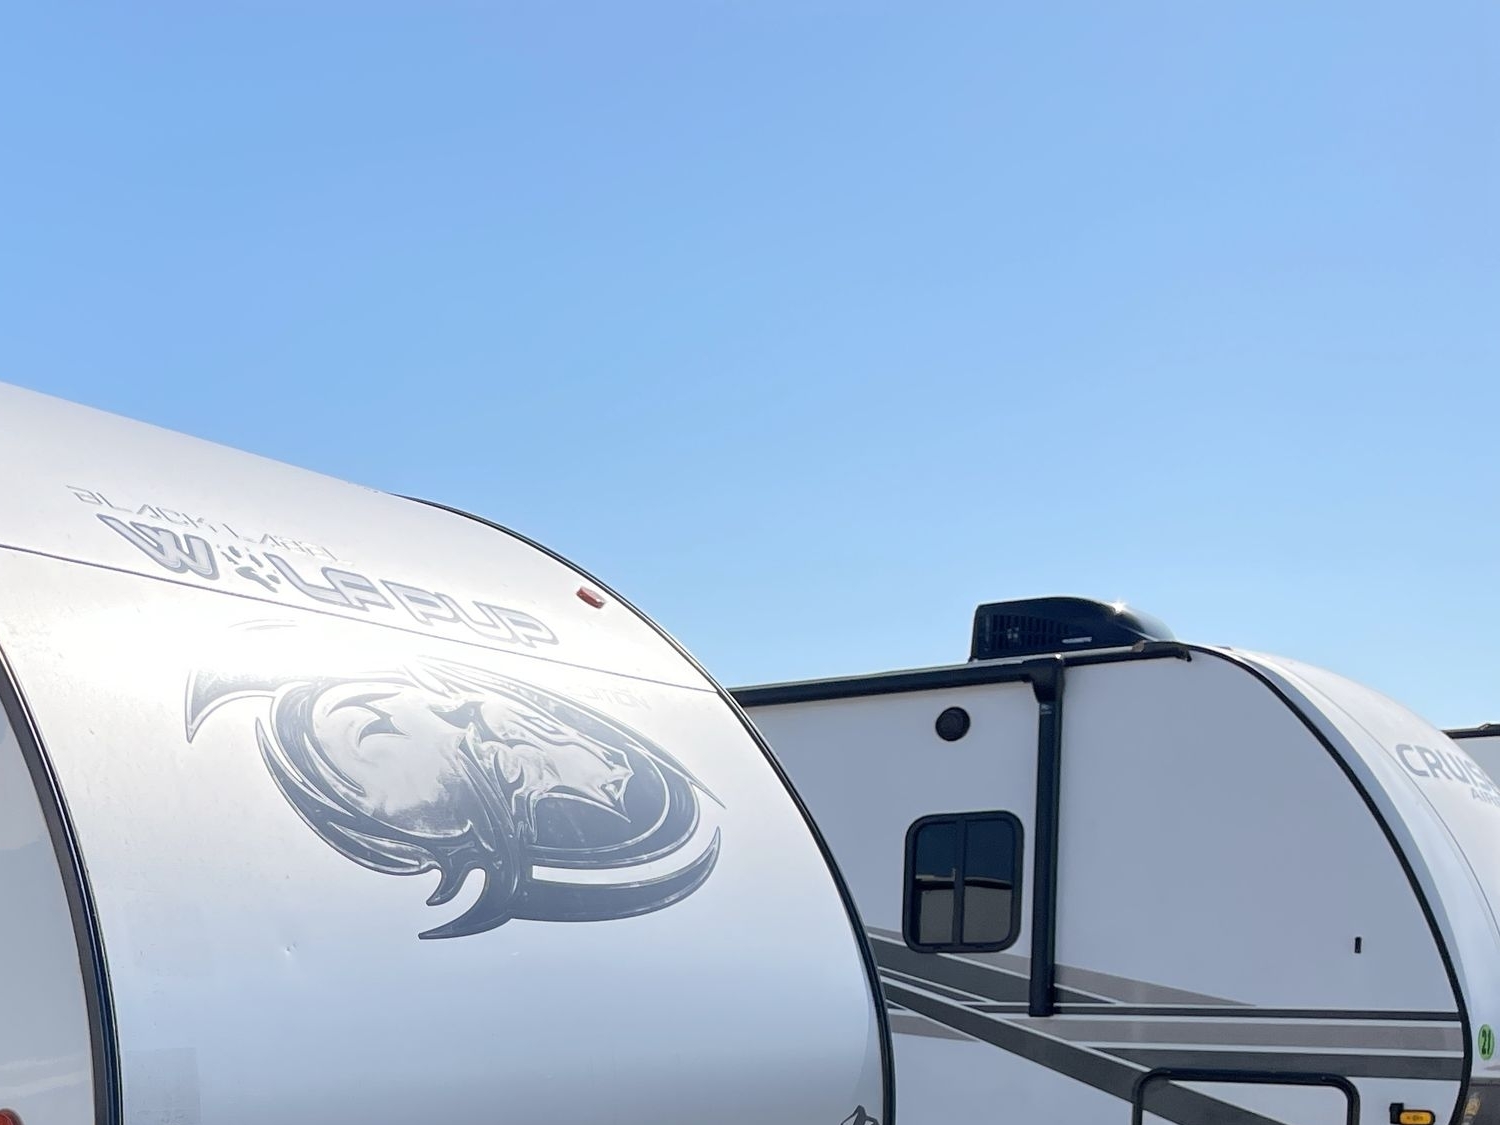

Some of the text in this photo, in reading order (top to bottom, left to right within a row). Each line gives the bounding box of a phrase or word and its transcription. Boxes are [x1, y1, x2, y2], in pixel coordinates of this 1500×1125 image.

[66, 485, 355, 566] BLACK LABEL
[382, 579, 560, 649] PUP
